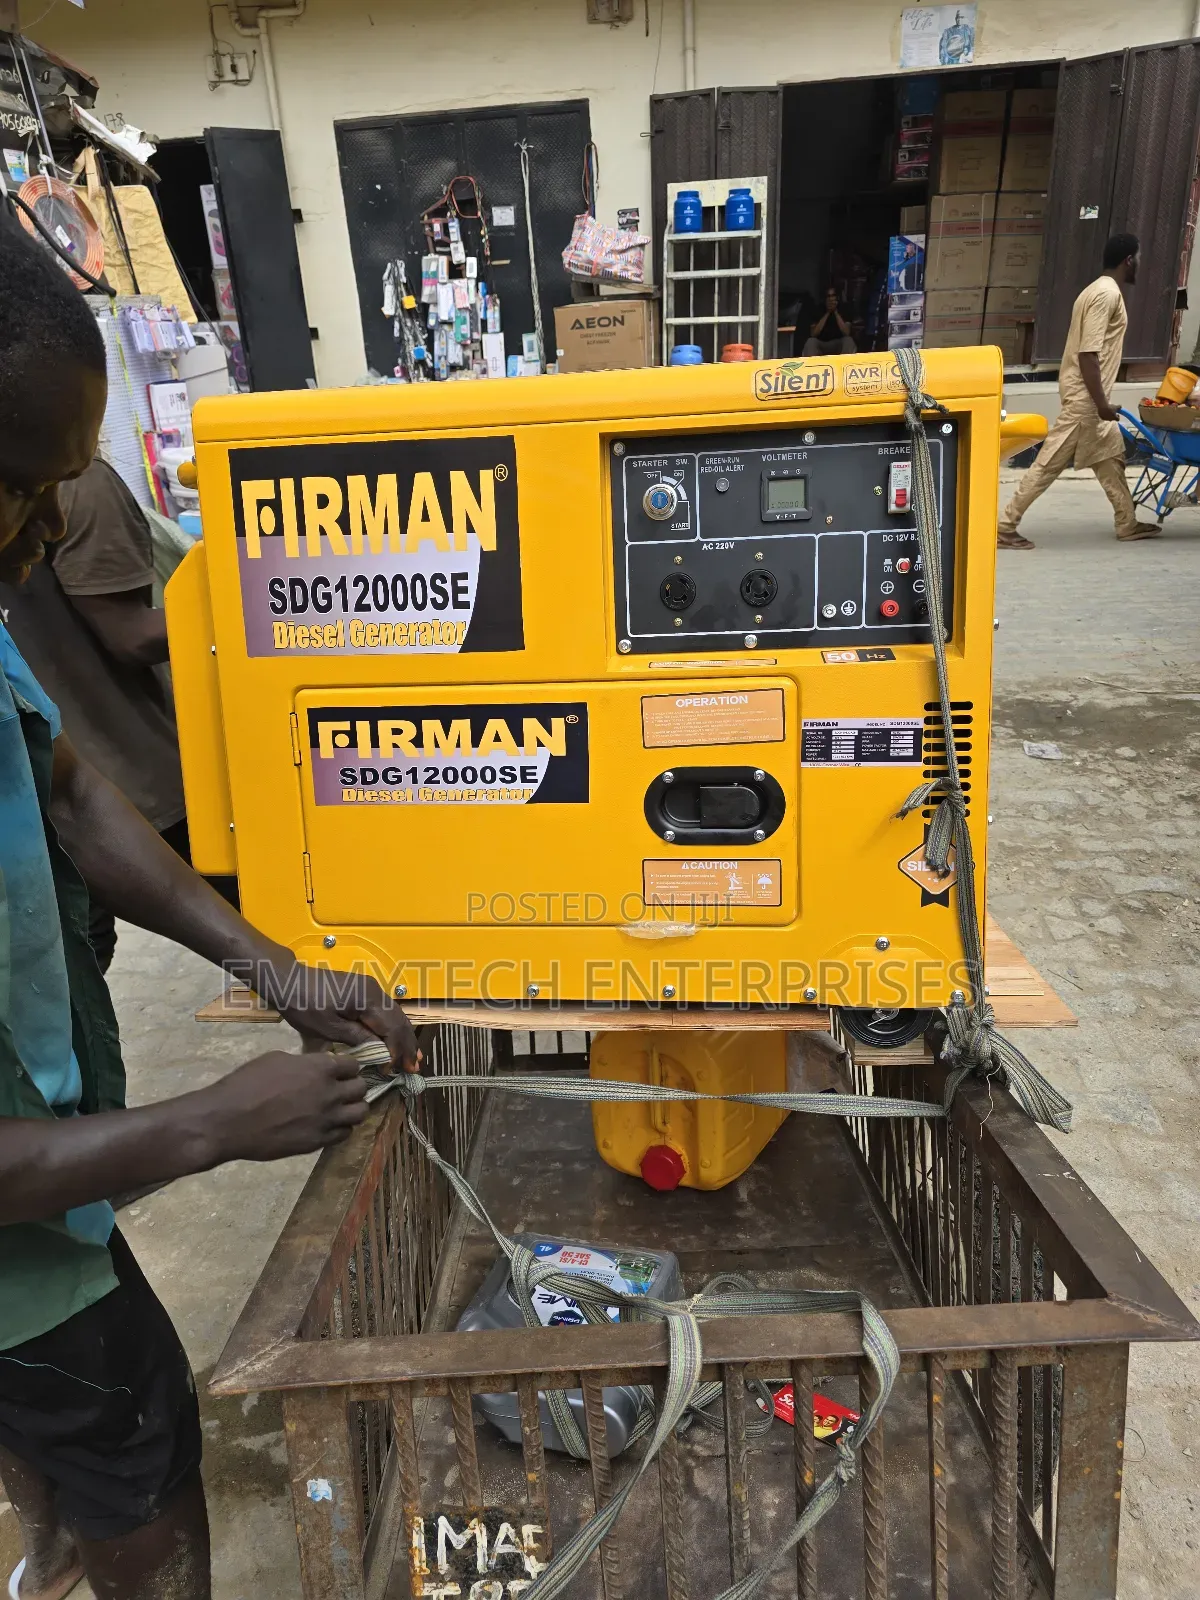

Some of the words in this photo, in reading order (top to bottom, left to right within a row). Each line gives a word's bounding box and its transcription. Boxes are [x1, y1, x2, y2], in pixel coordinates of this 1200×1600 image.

[570, 315, 625, 331] AEON
[848, 366, 880, 380] AVR
[759, 368, 831, 394] Silent
[852, 384, 878, 393] system
[878, 446, 911, 455] BREAKE
[705, 456, 740, 465] GREEN-RUN
[761, 451, 808, 462] VOLTMETER
[632, 459, 669, 468] STARTER
[675, 458, 690, 466] SW.
[725, 464, 745, 472] ALERT
[241, 468, 498, 559] FIRMAN
[882, 534, 894, 542] DC
[895, 533, 909, 542] 12V
[702, 542, 714, 551] AC
[715, 541, 735, 550] 220V
[883, 565, 893, 573] ON
[914, 563, 924, 571] OF
[268, 571, 471, 615] SDG12000SE
[273, 619, 345, 649] Diesel
[348, 618, 467, 648] Generator
[826, 651, 856, 662] 50
[675, 695, 749, 708] OPERATION
[317, 717, 567, 759] FIRMAN
[339, 765, 539, 786] SDG12000SE
[341, 787, 414, 802] Diesel
[418, 786, 534, 801] Generator
[690, 861, 738, 870] CAUTION
[561, 1250, 575, 1259] 50
[575, 1251, 592, 1260] SAE
